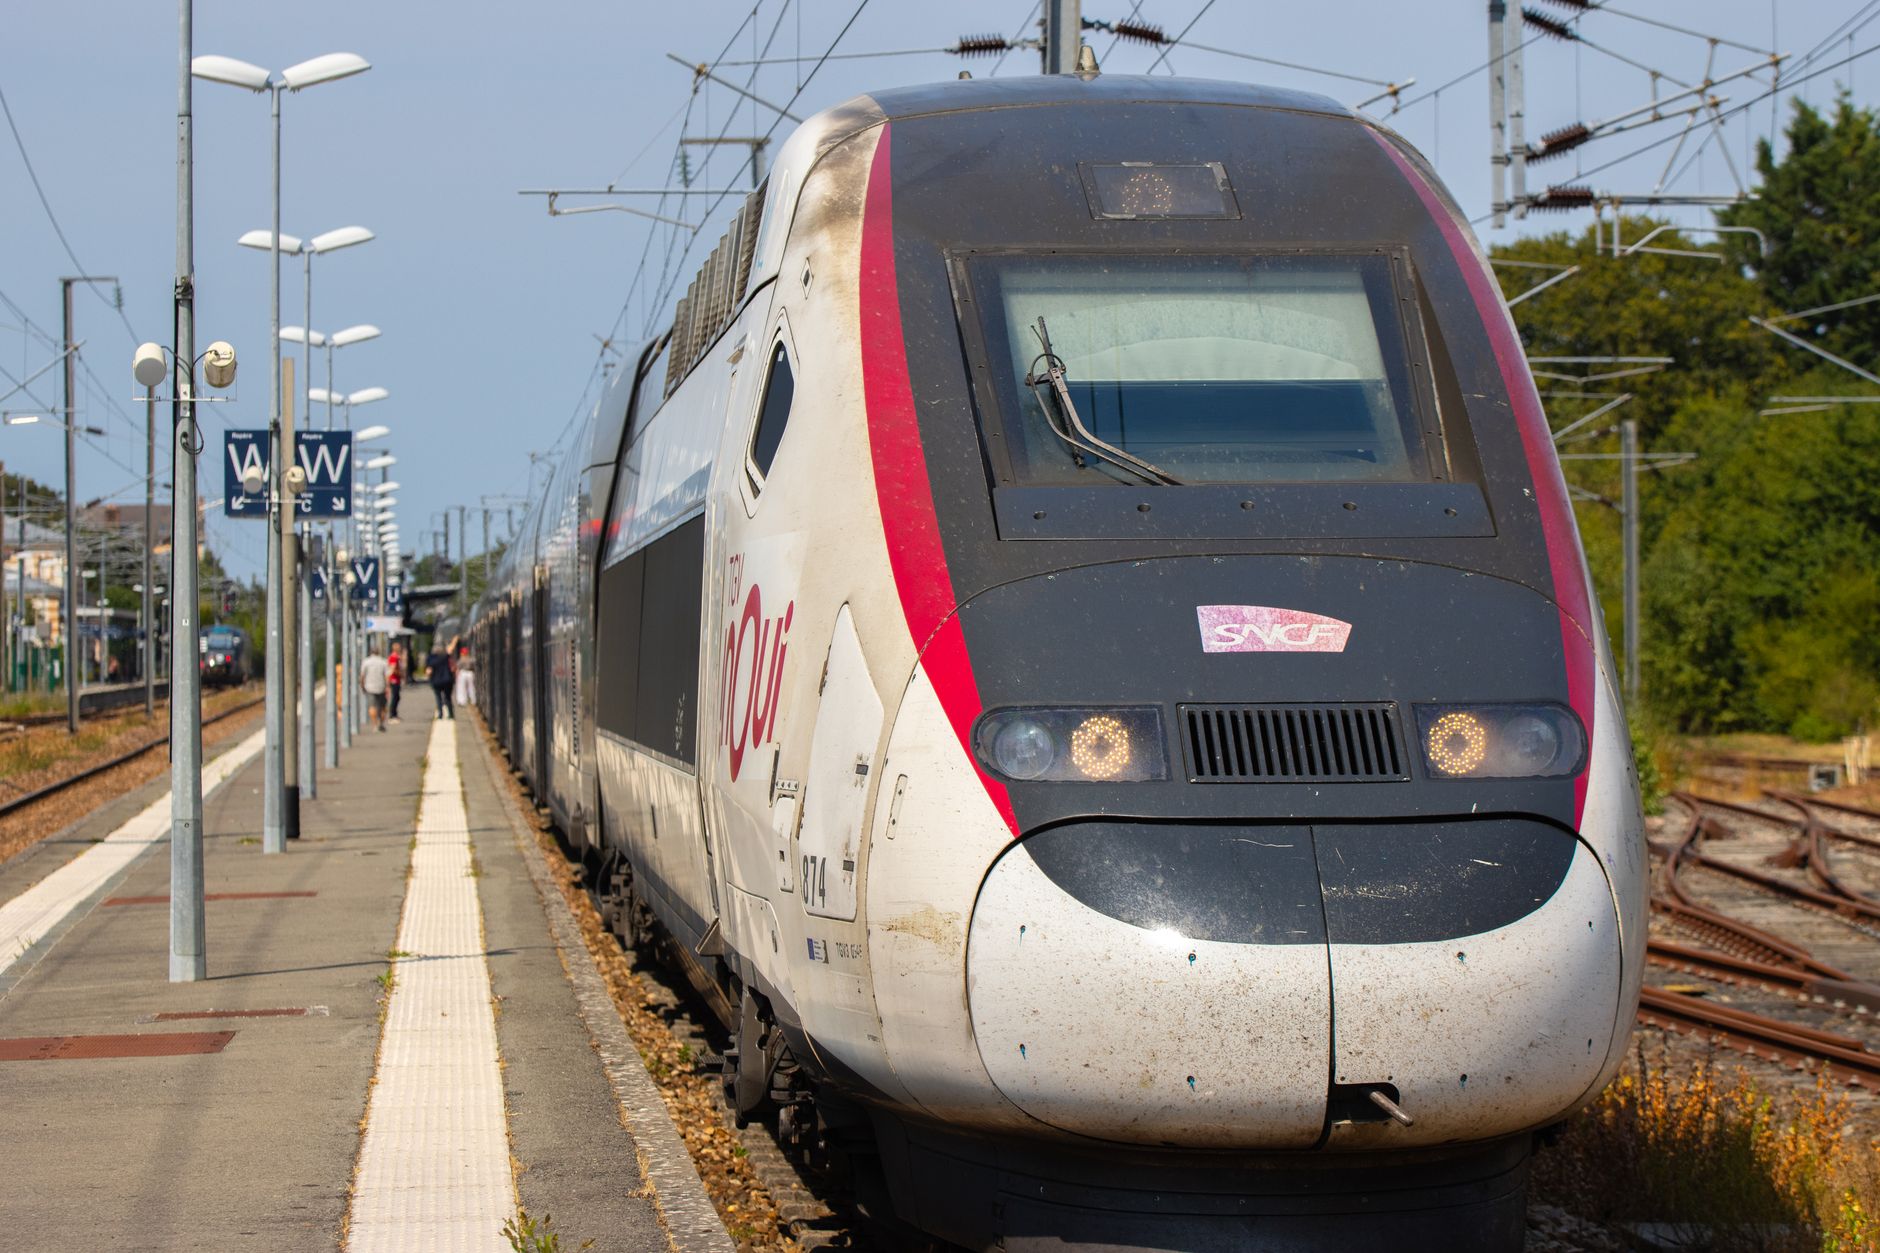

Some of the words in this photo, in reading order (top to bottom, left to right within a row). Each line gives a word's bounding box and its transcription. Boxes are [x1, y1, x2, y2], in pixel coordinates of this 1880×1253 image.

[298, 444, 349, 484] W
[301, 499, 312, 513] C
[355, 562, 375, 584] V
[727, 552, 746, 607] TGV
[1210, 623, 1340, 646] SNCF
[802, 854, 827, 909] 874
